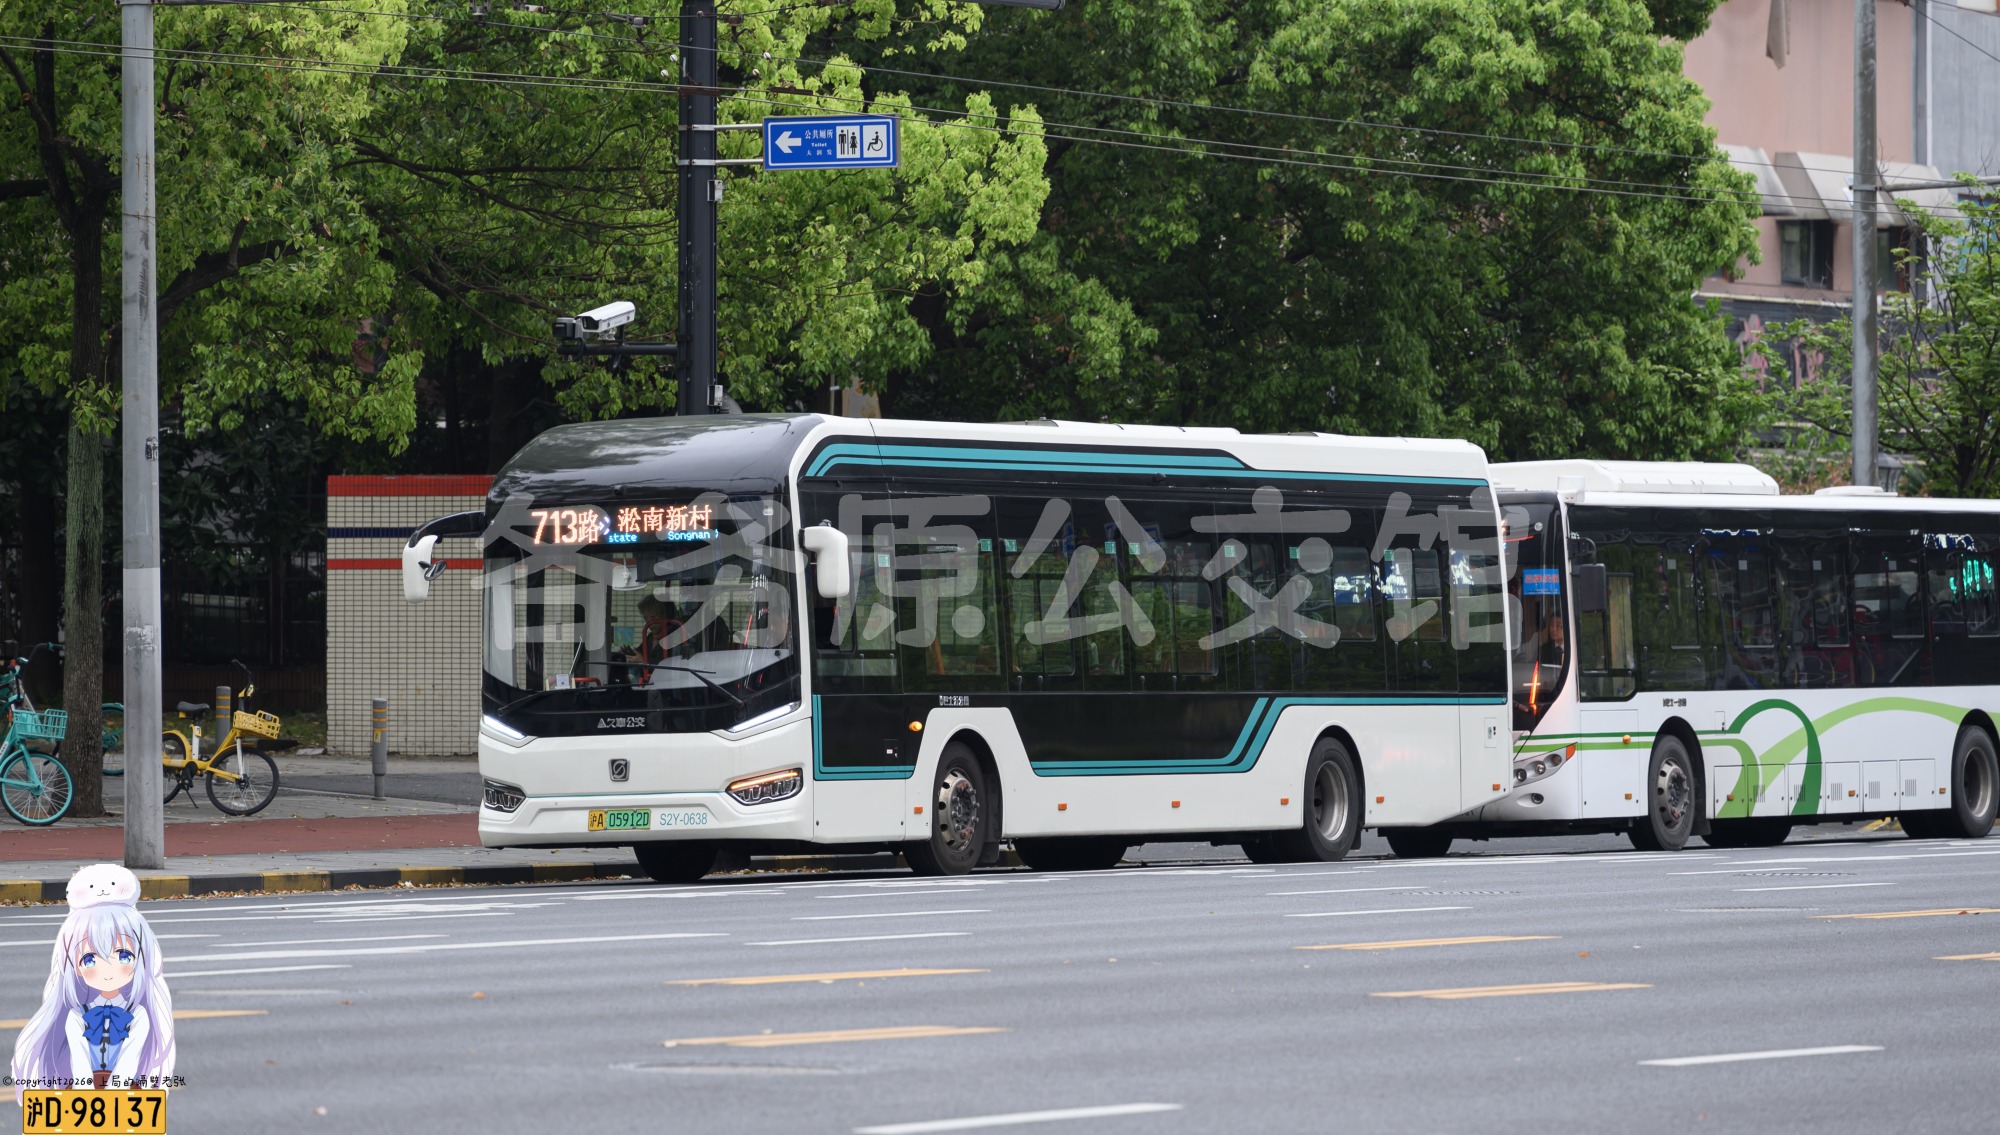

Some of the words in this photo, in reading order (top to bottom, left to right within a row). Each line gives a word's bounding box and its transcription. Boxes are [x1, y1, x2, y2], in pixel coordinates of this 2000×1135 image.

[804, 128, 834, 140] 公共厕所
[531, 509, 600, 545] 713路
[617, 504, 713, 533] 淞南新村
[667, 530, 711, 541] Songnan
[659, 813, 708, 826] S2Y-0638
